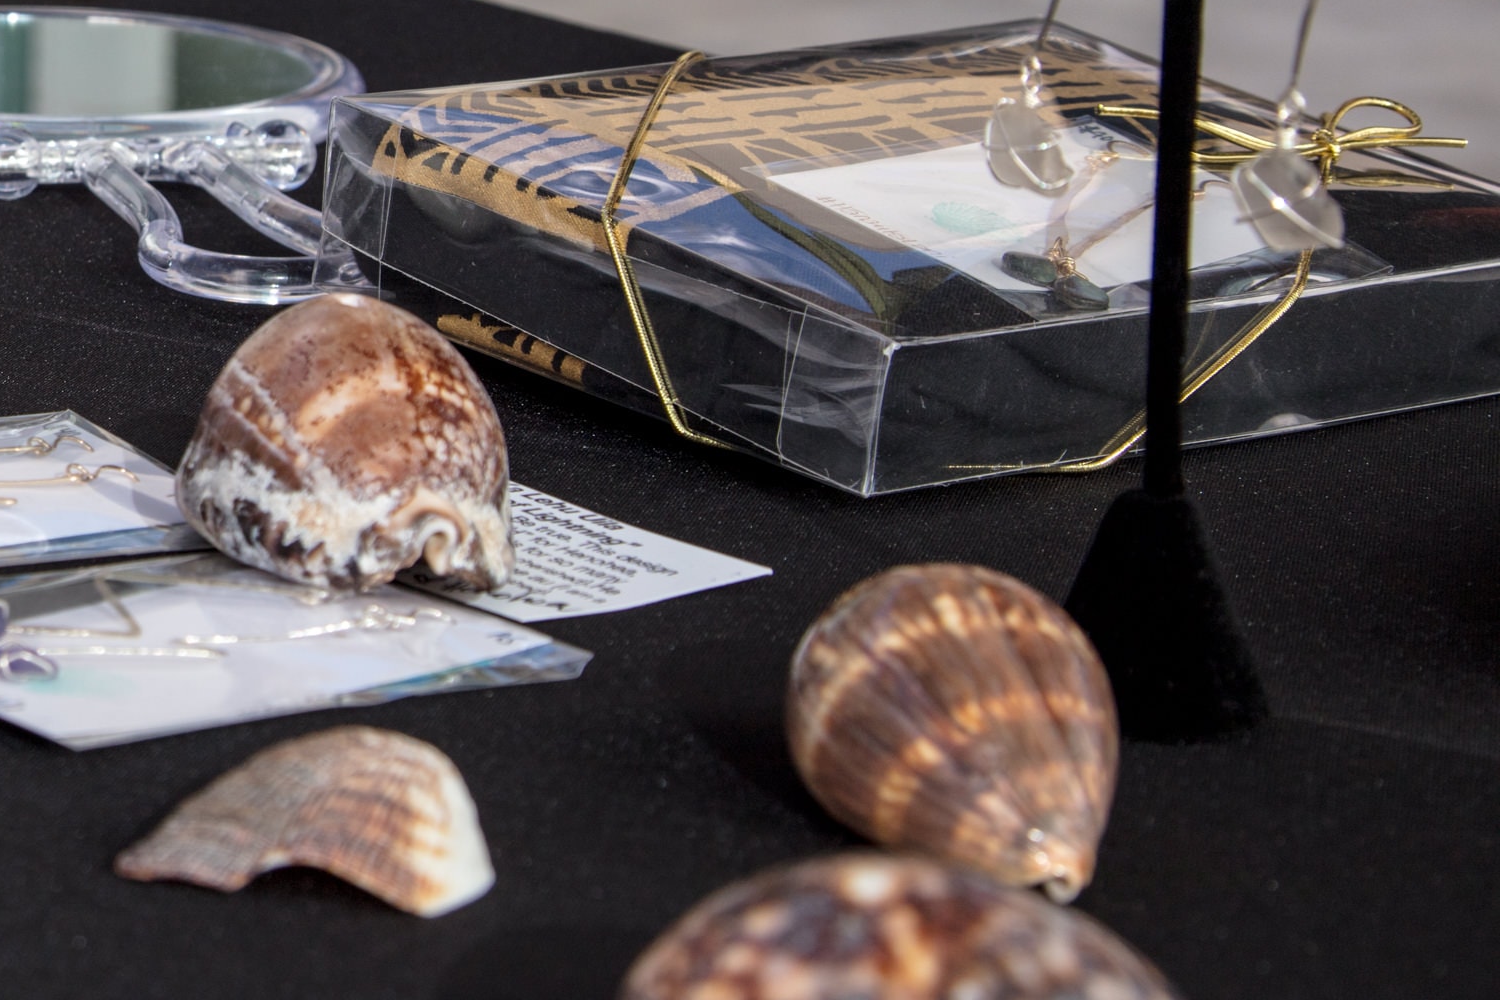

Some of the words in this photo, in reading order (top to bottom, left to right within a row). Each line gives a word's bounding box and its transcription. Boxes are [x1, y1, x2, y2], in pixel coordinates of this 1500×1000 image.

[521, 492, 580, 515] Lehu
[579, 514, 625, 531] Uila
[530, 537, 560, 547] for
[579, 540, 617, 556] This
[615, 555, 679, 576] design
